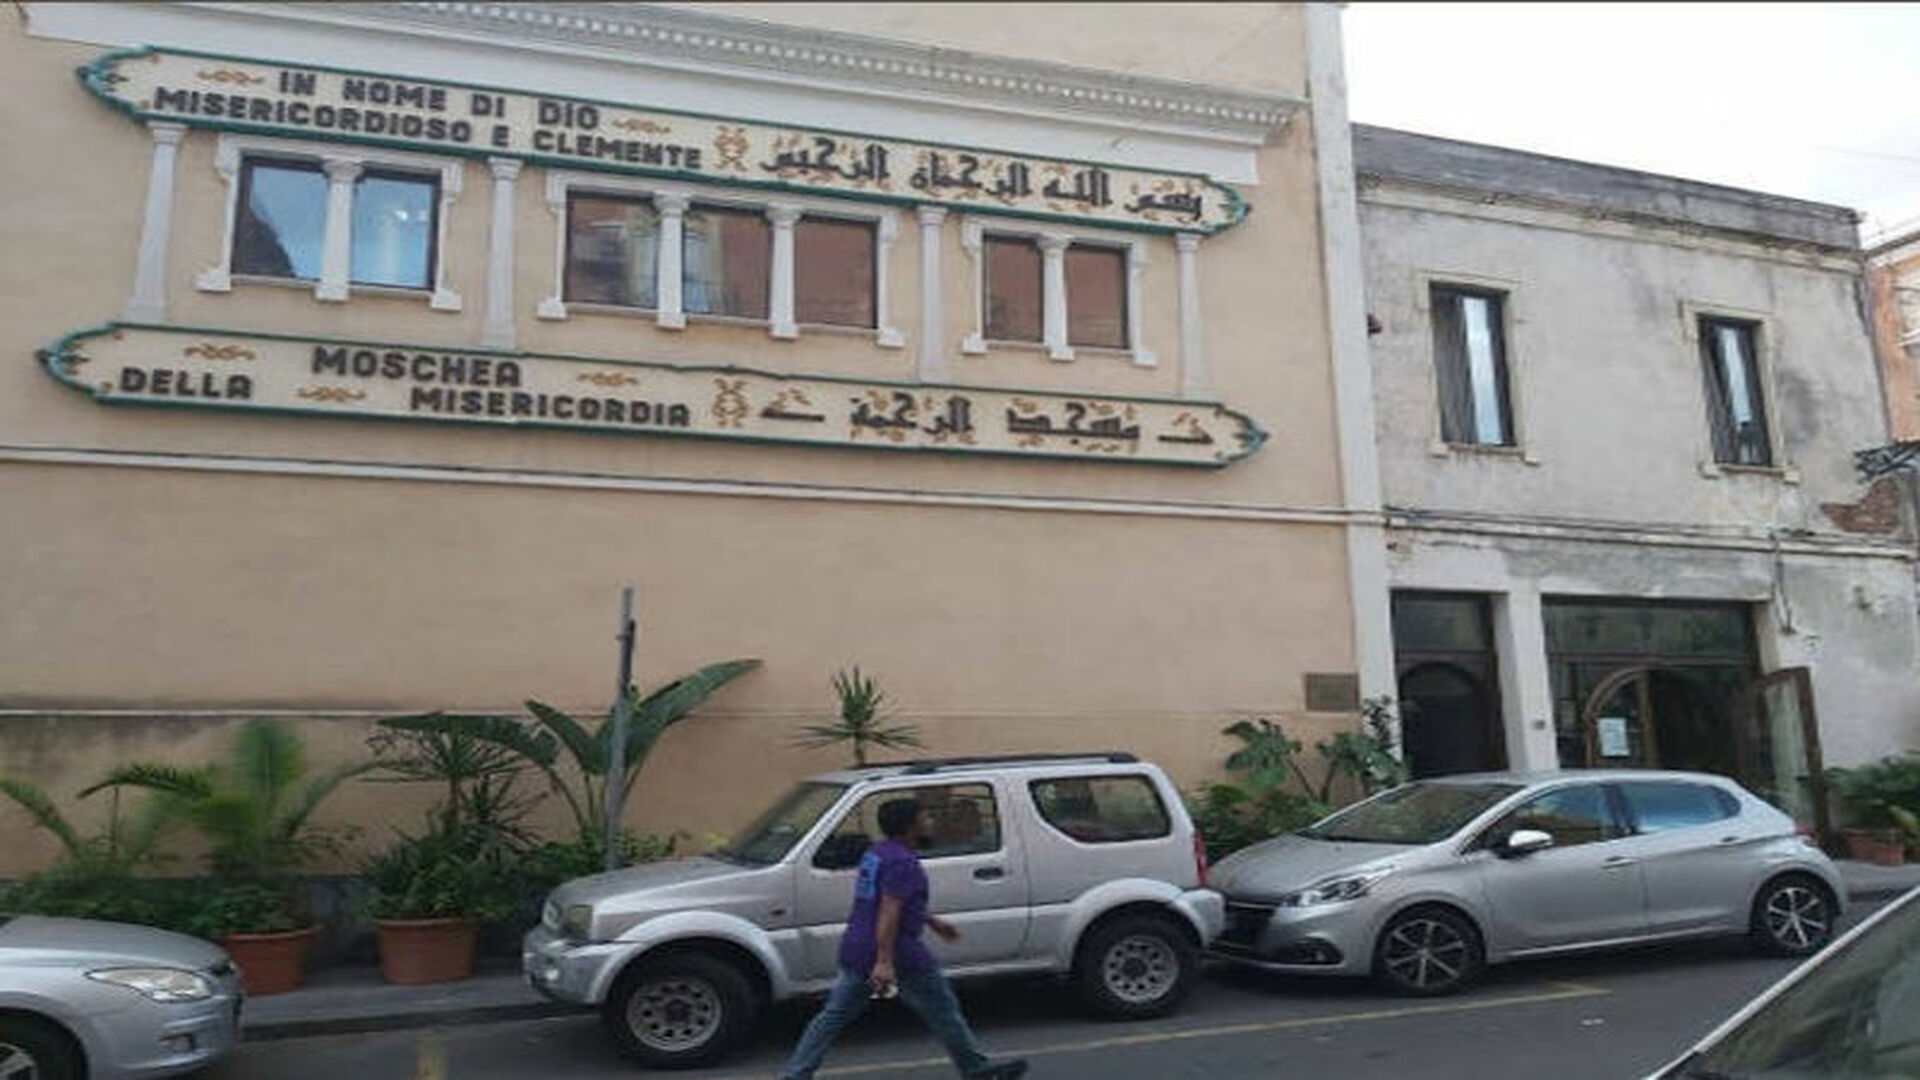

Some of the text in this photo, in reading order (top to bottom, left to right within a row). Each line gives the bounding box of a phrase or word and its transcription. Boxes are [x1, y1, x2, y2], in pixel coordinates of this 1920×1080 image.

[279, 70, 599, 130] IN NOME DI DIO
[153, 86, 702, 169] MISERICORDIOSO E CLEMENTE
[760, 136, 890, 180] الرحيم
[1042, 167, 1114, 208] الله
[312, 346, 522, 387] MOSCHEA
[119, 366, 691, 426] DELLA MISERICORDIA
[1005, 401, 1141, 445] مسجد
